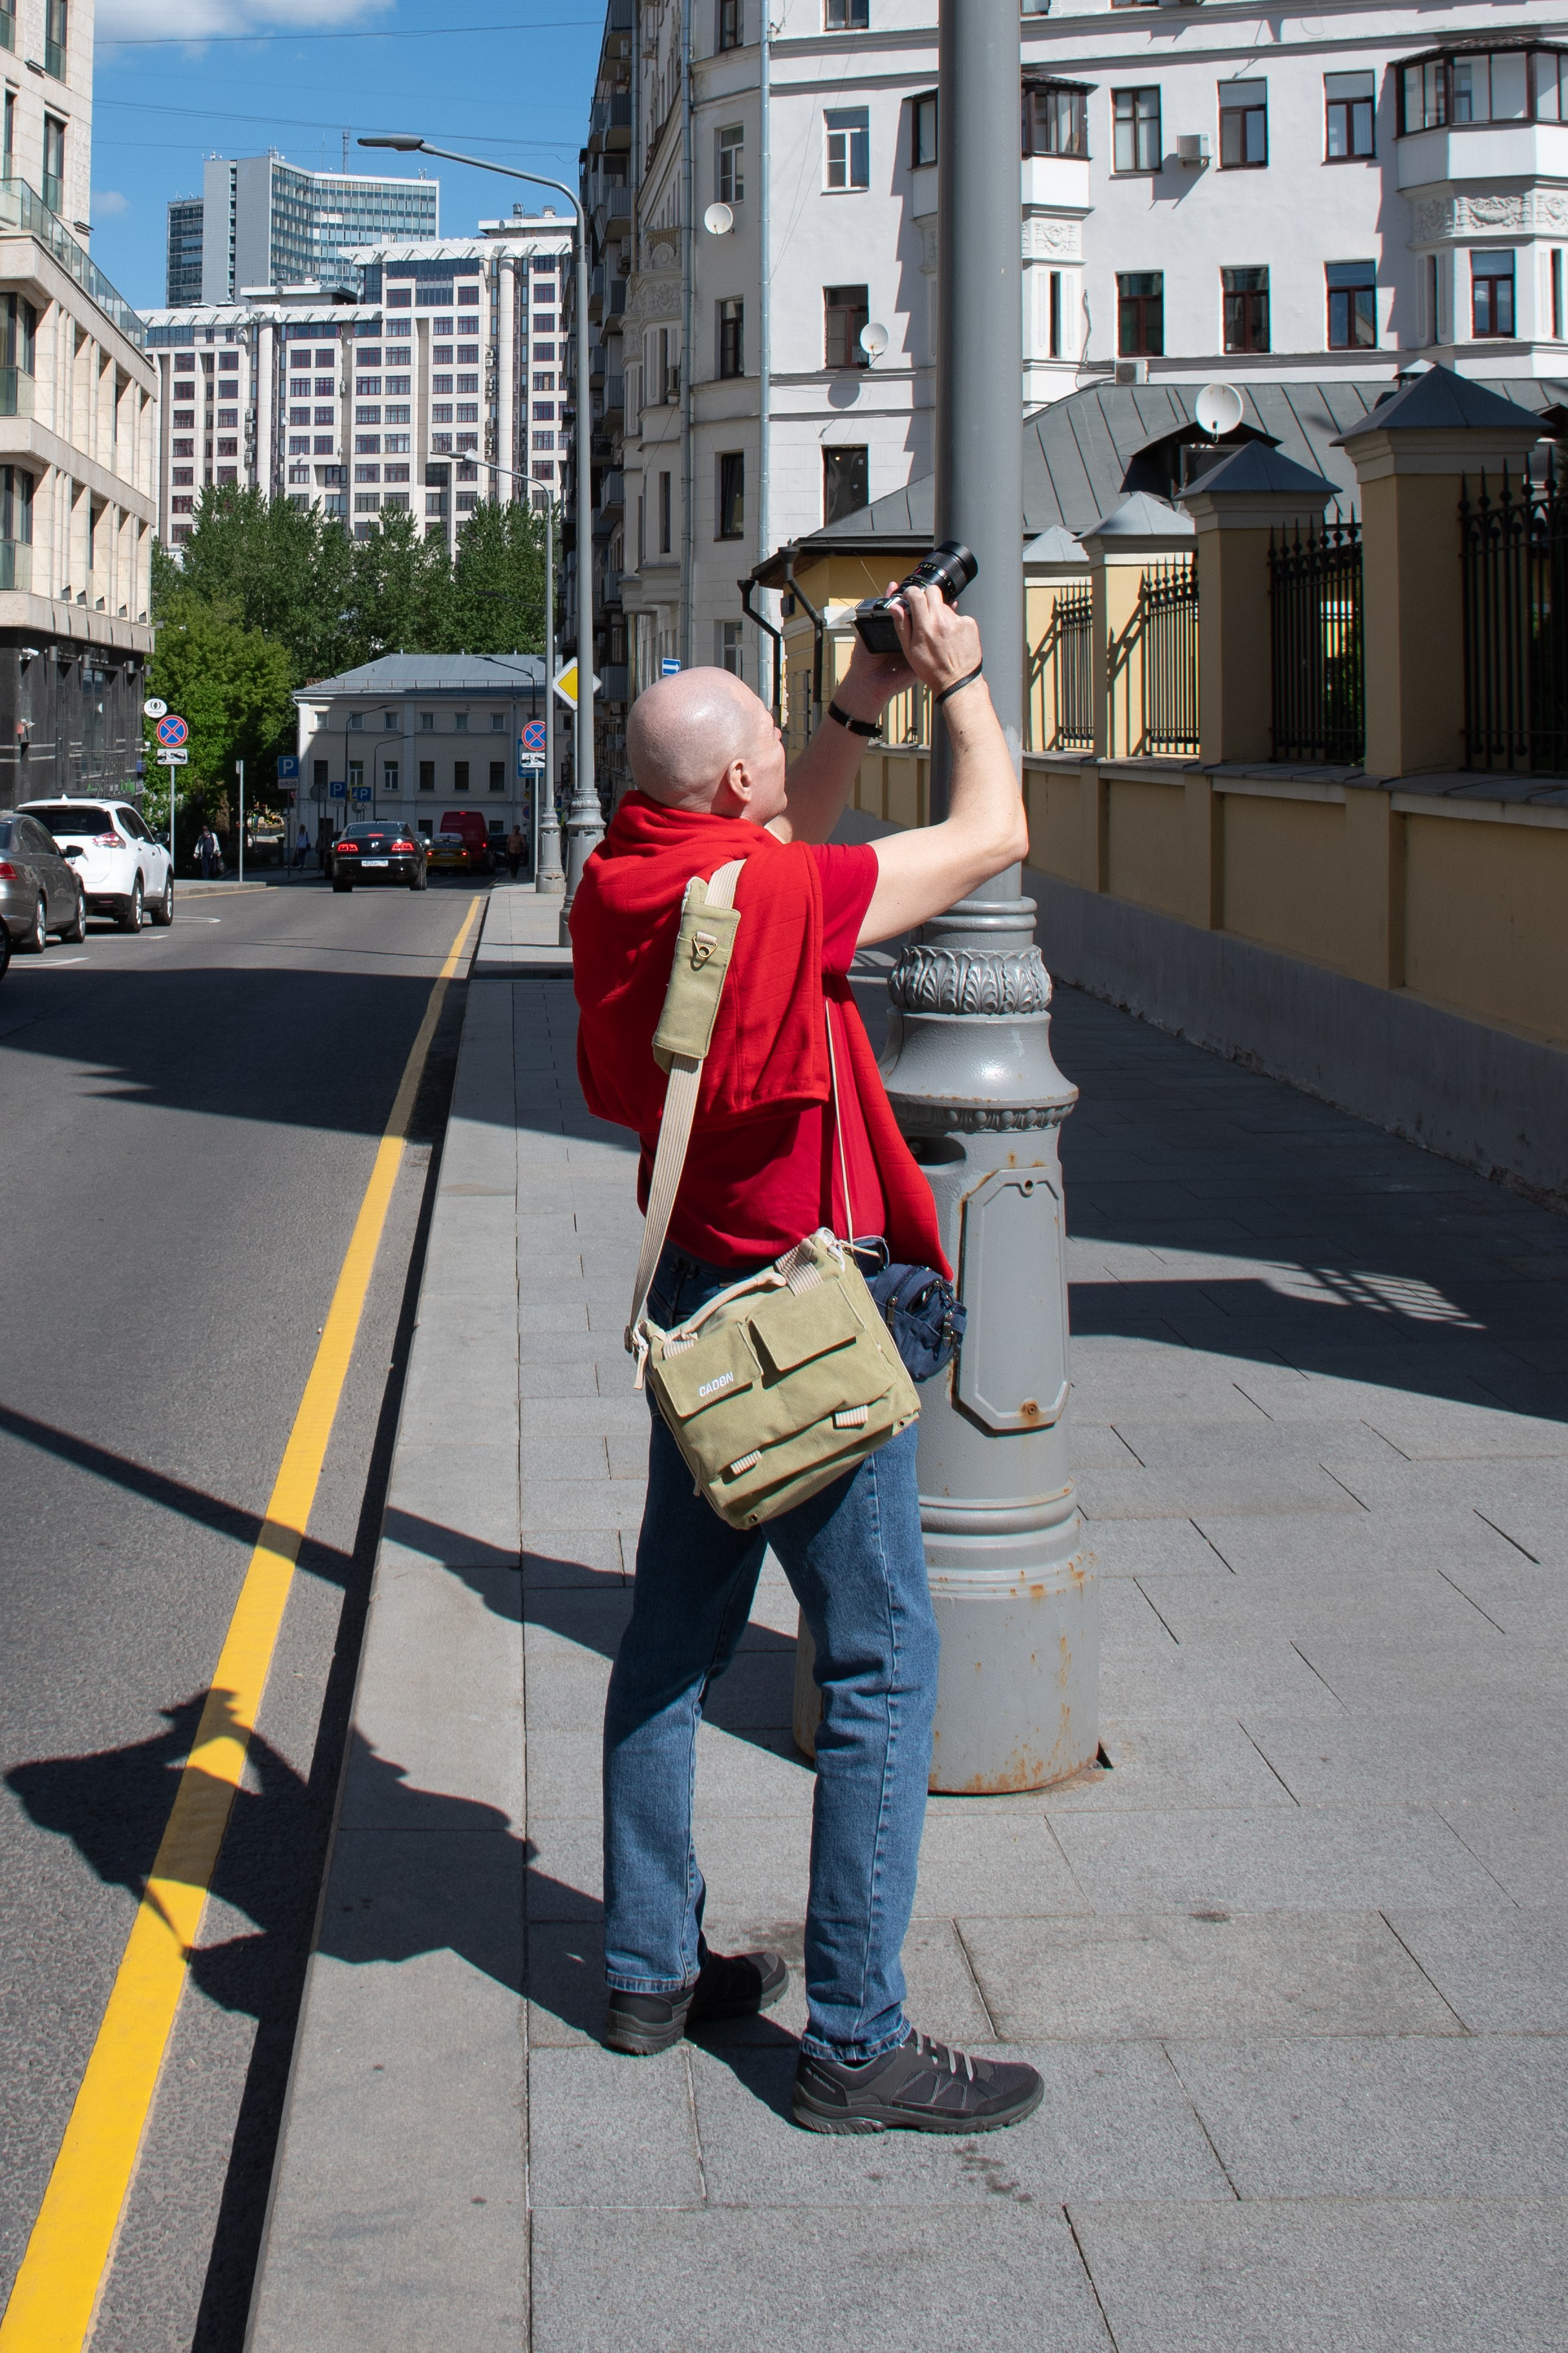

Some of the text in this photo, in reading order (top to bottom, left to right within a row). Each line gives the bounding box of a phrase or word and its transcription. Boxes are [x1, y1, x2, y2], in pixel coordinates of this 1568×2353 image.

[283, 759, 294, 774] P
[333, 783, 342, 796] P
[360, 788, 368, 799] P
